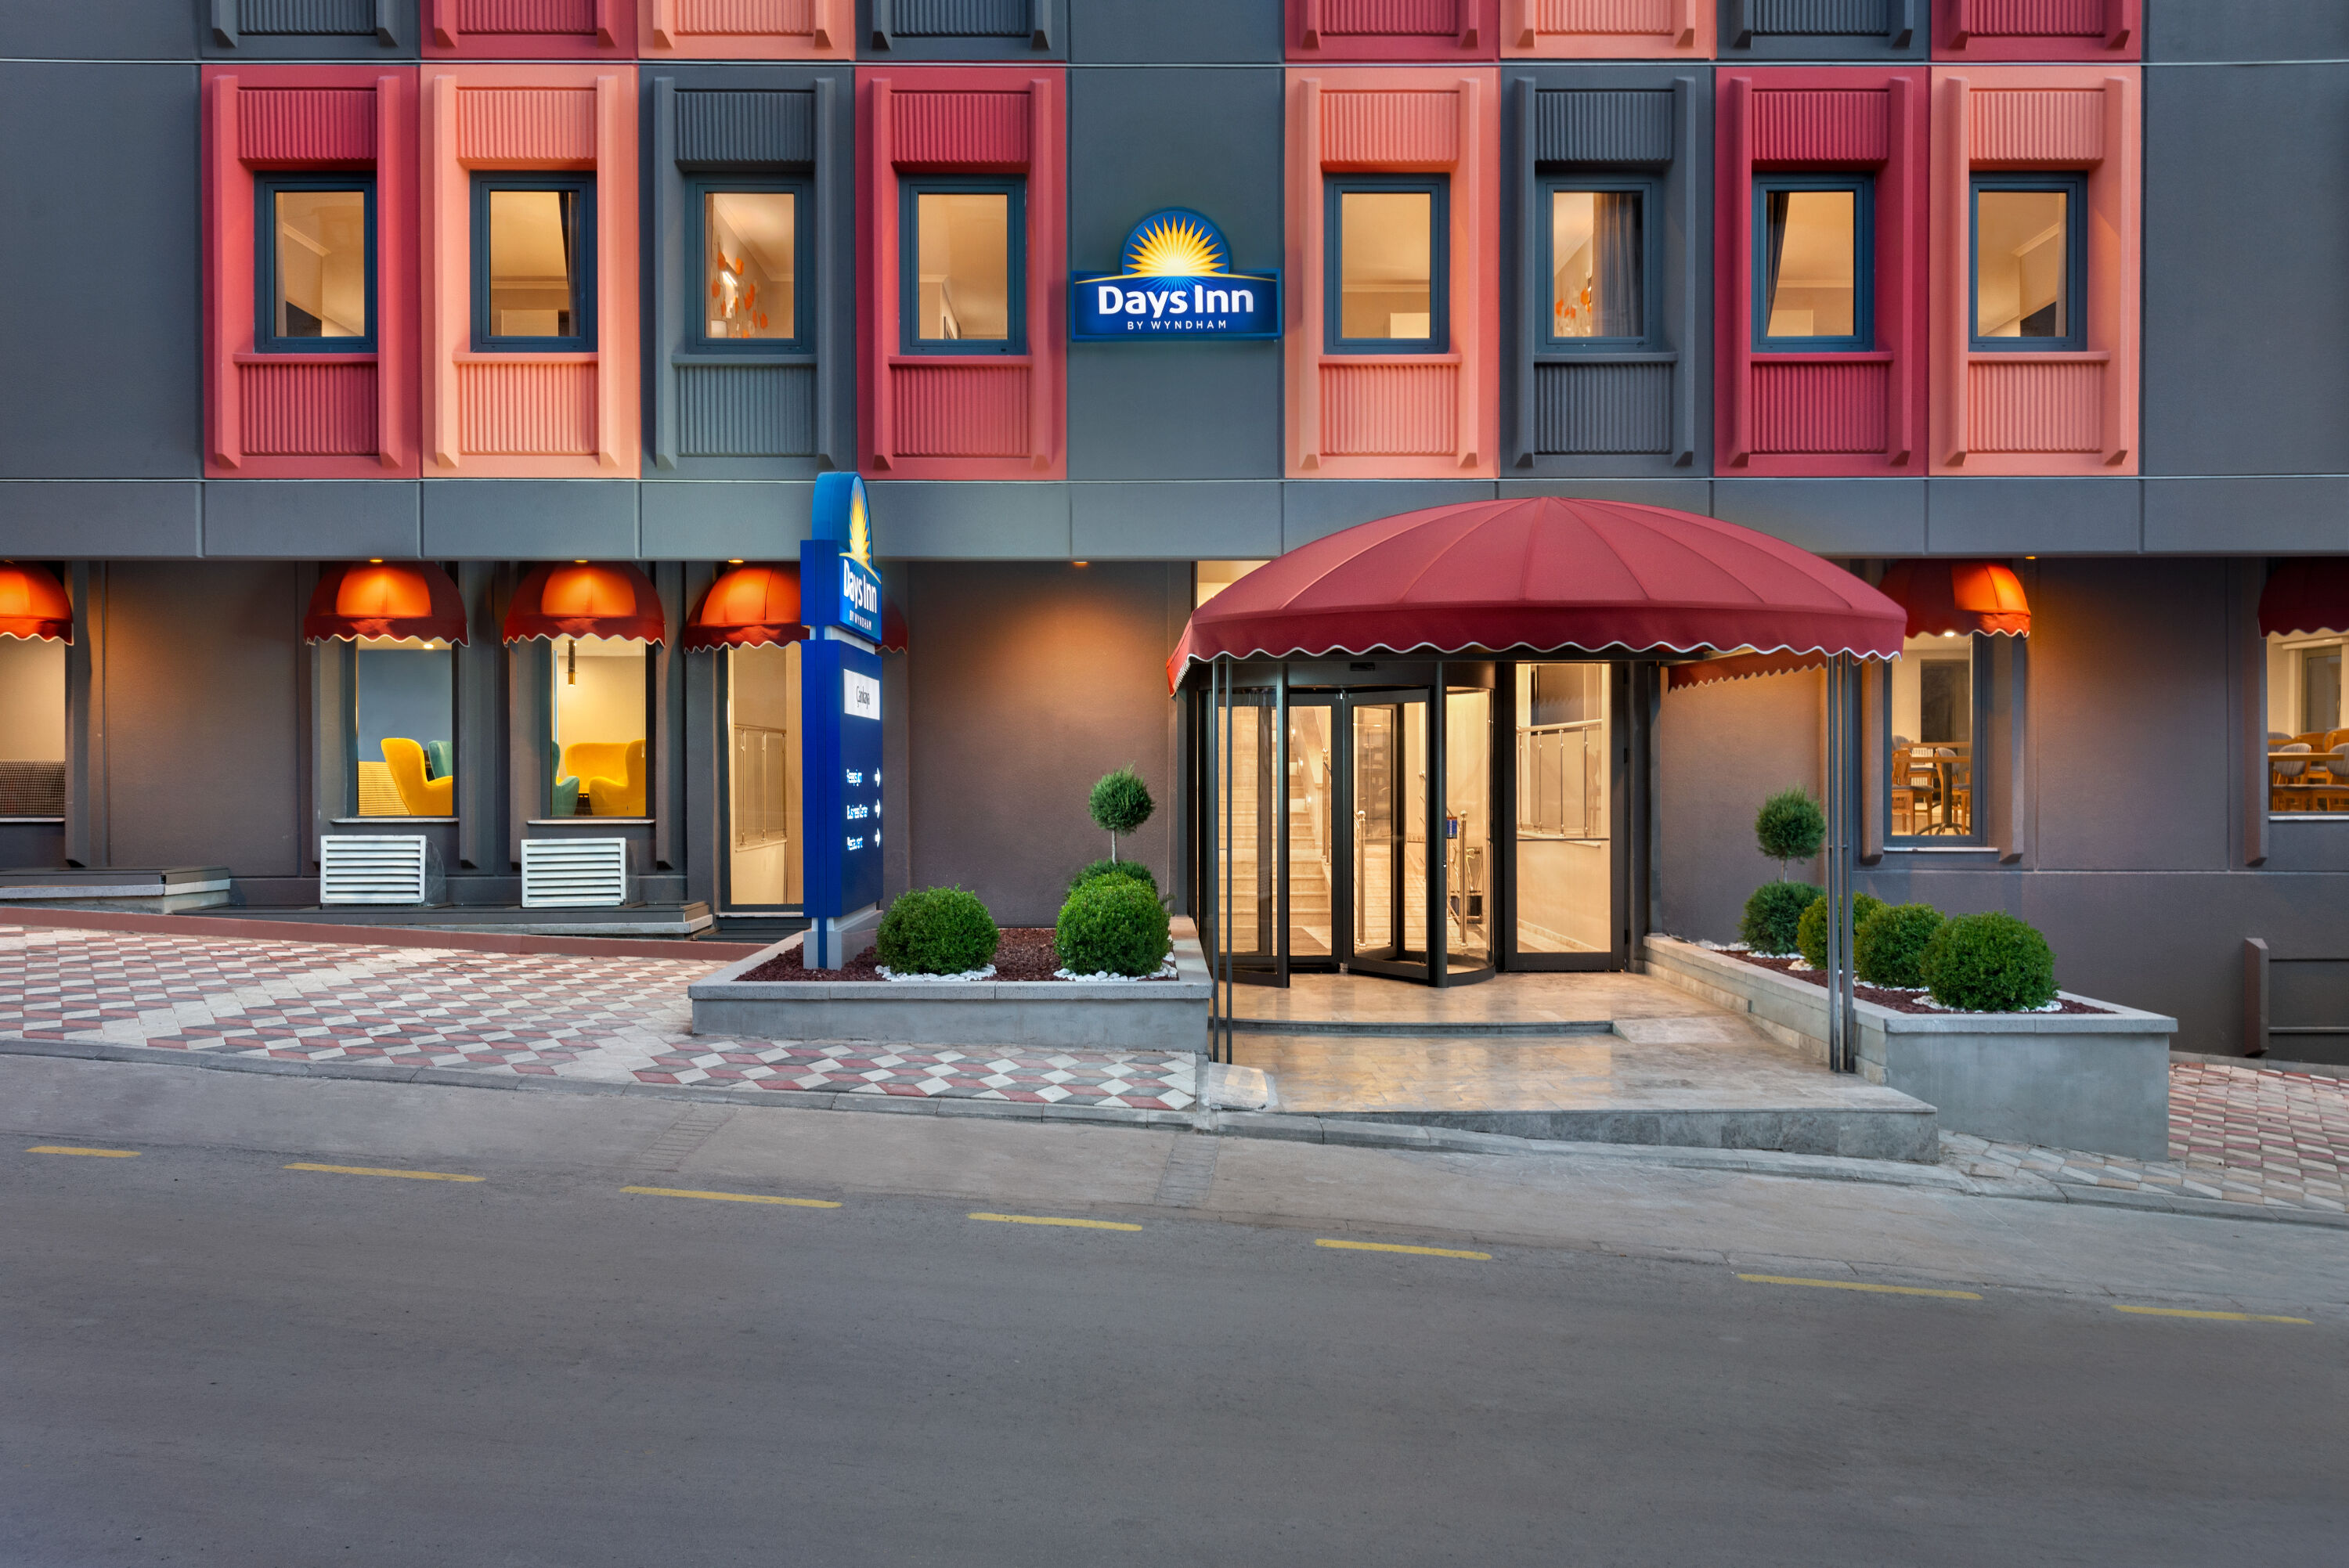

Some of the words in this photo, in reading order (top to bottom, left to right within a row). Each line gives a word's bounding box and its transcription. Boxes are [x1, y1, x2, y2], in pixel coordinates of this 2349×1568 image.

[1098, 286, 1187, 319] Days
[1194, 285, 1254, 314] Inn
[1128, 321, 1143, 330] BY
[1151, 320, 1226, 330] WYNDHAM
[843, 558, 863, 610] Days
[863, 574, 877, 614] Inn
[850, 610, 854, 622] BY
